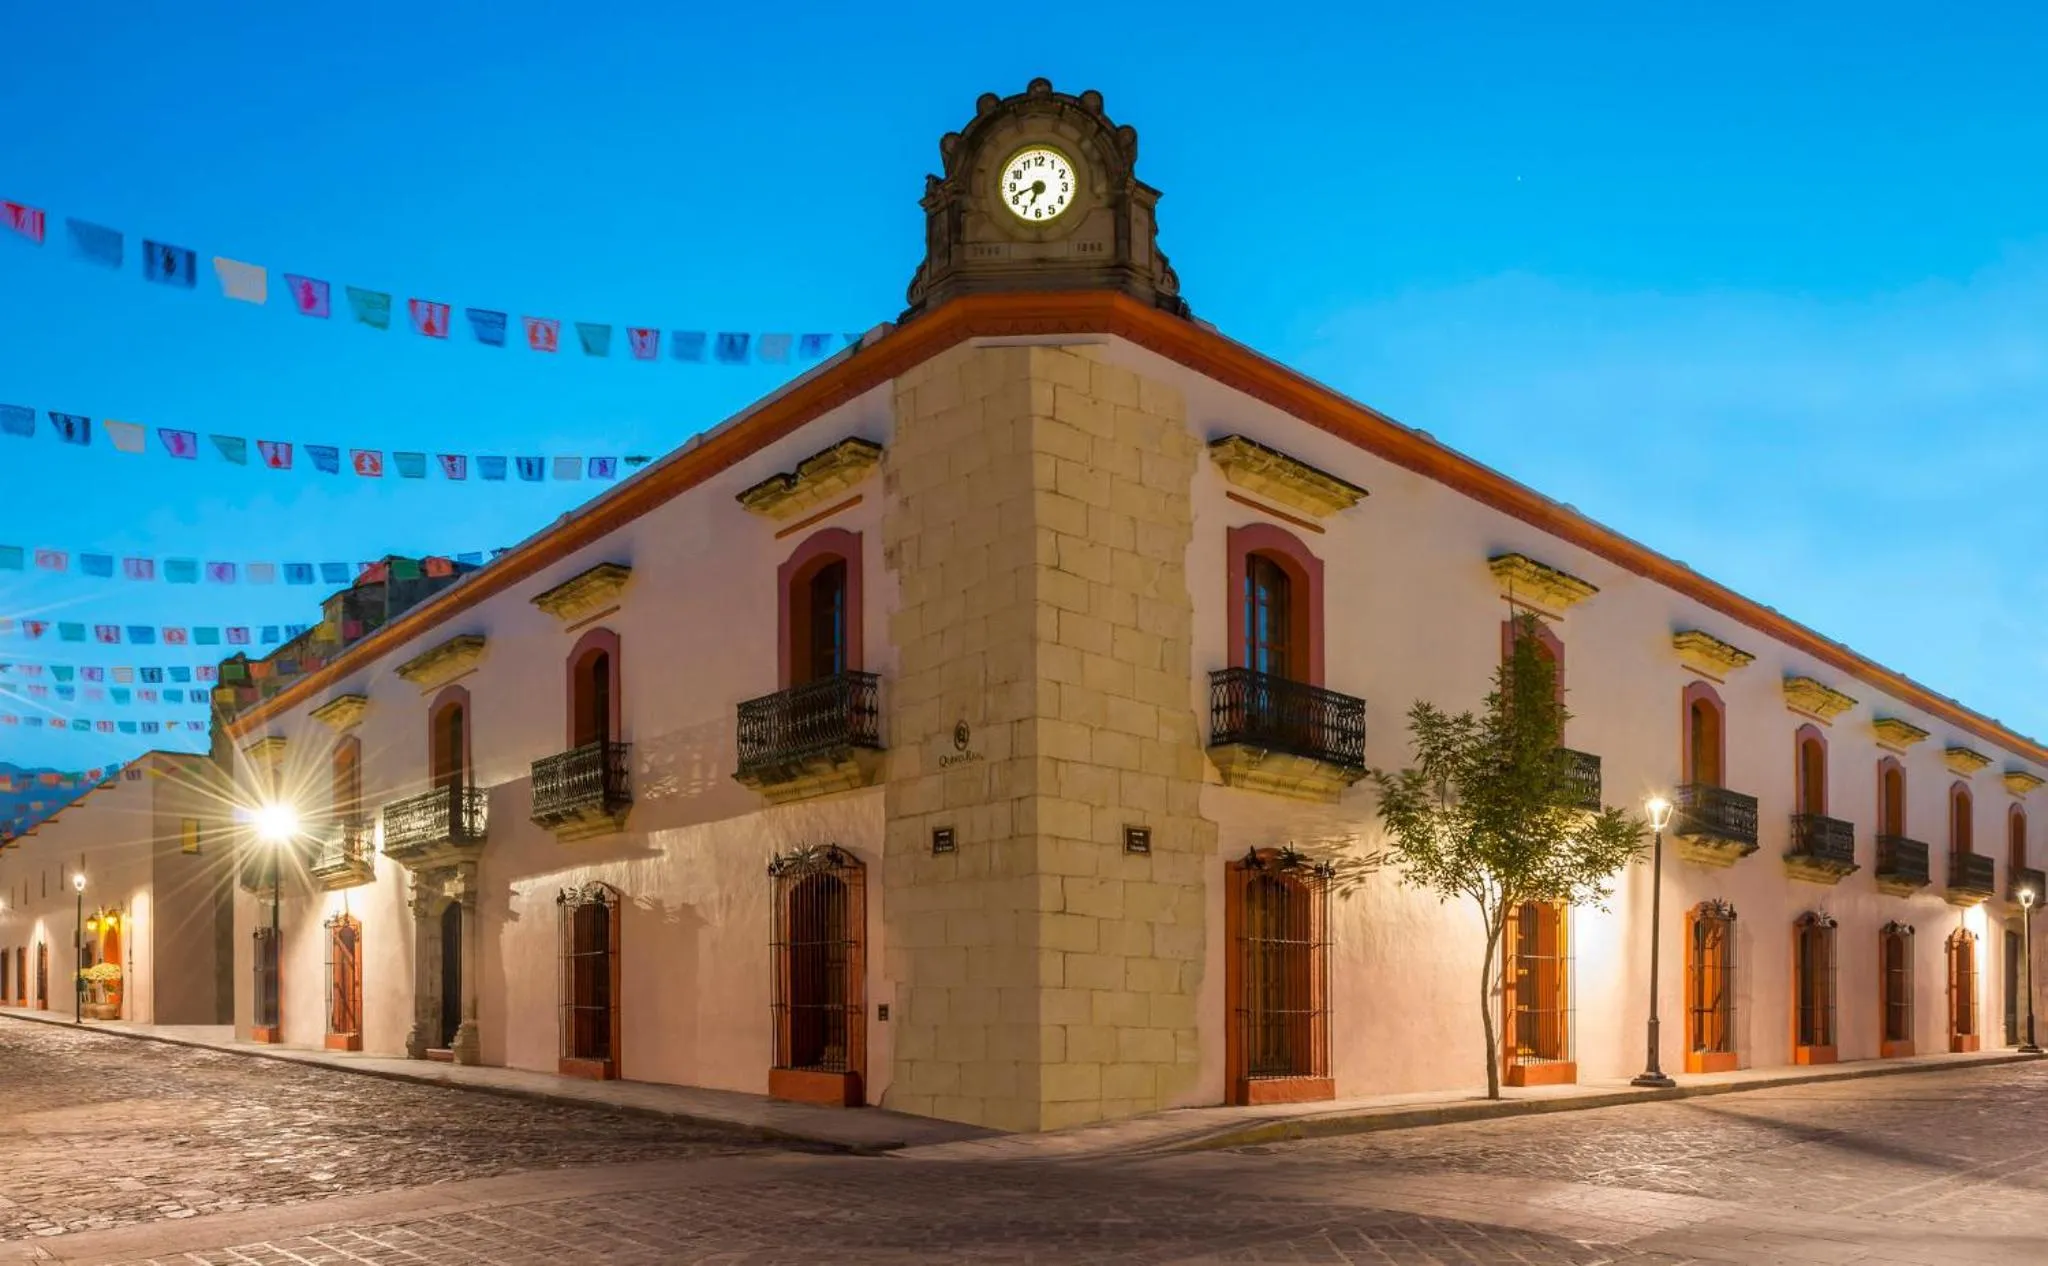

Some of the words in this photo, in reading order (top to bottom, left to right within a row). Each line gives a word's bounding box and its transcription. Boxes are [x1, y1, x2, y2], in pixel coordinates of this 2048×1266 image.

[1022, 160, 1030, 171] 11
[1034, 156, 1045, 166] 12
[1012, 170, 1022, 180] 10
[1058, 168, 1066, 179] 2
[1009, 182, 1016, 192] 9
[1062, 182, 1068, 192] 3
[1012, 194, 1020, 205] 8
[1058, 195, 1064, 205] 4
[1022, 205, 1028, 215] 7
[1034, 208, 1042, 218] 6
[1048, 204, 1056, 214] 5
